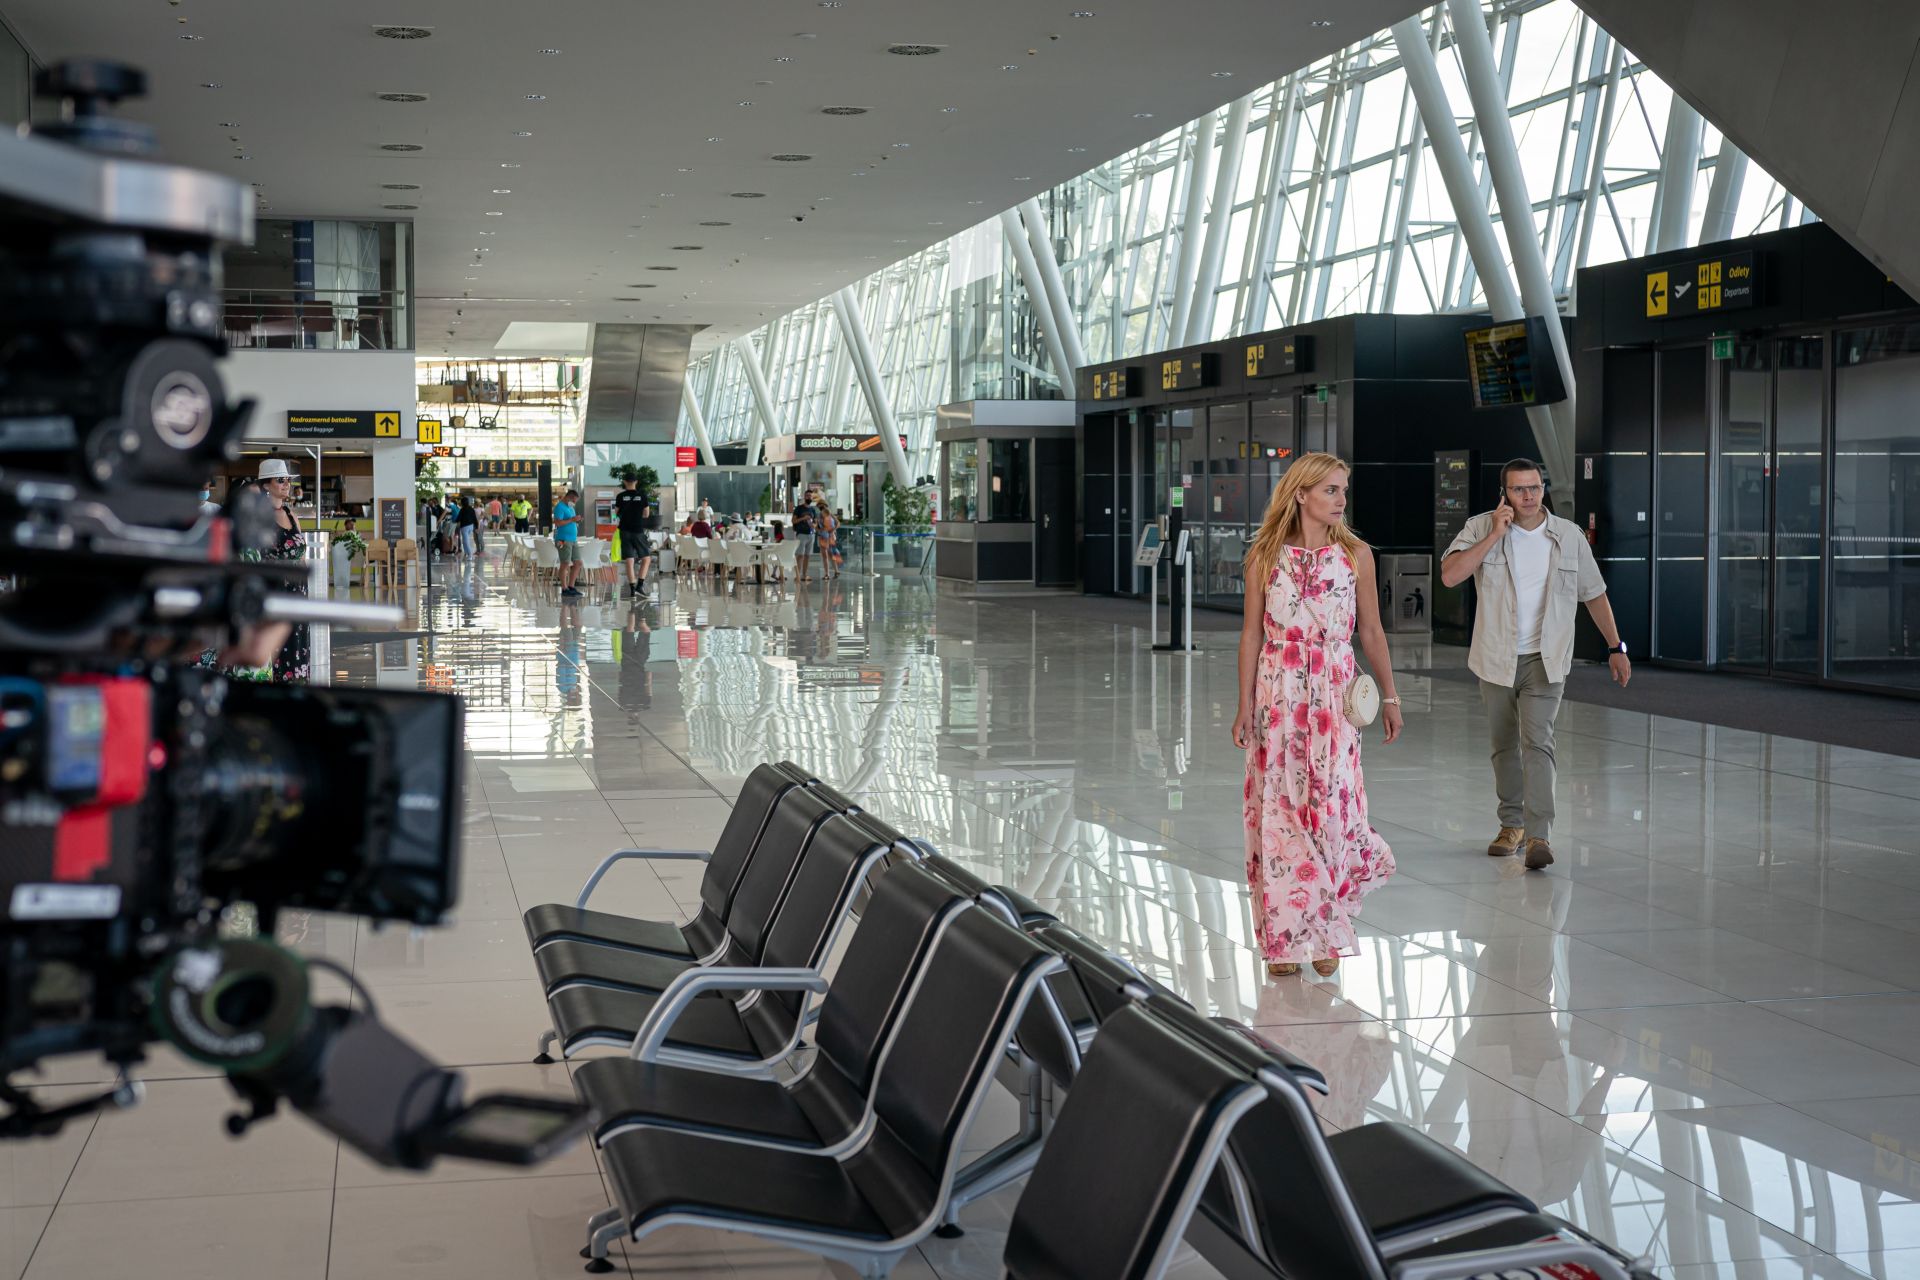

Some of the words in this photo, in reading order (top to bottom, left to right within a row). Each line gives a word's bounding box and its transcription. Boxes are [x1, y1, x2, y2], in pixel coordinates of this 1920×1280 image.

[1729, 266, 1750, 279] Odlety
[1724, 287, 1749, 298] Departures
[313, 426, 334, 434] Baggage
[801, 436, 830, 448] snack
[831, 436, 842, 448] to
[842, 438, 857, 450] go
